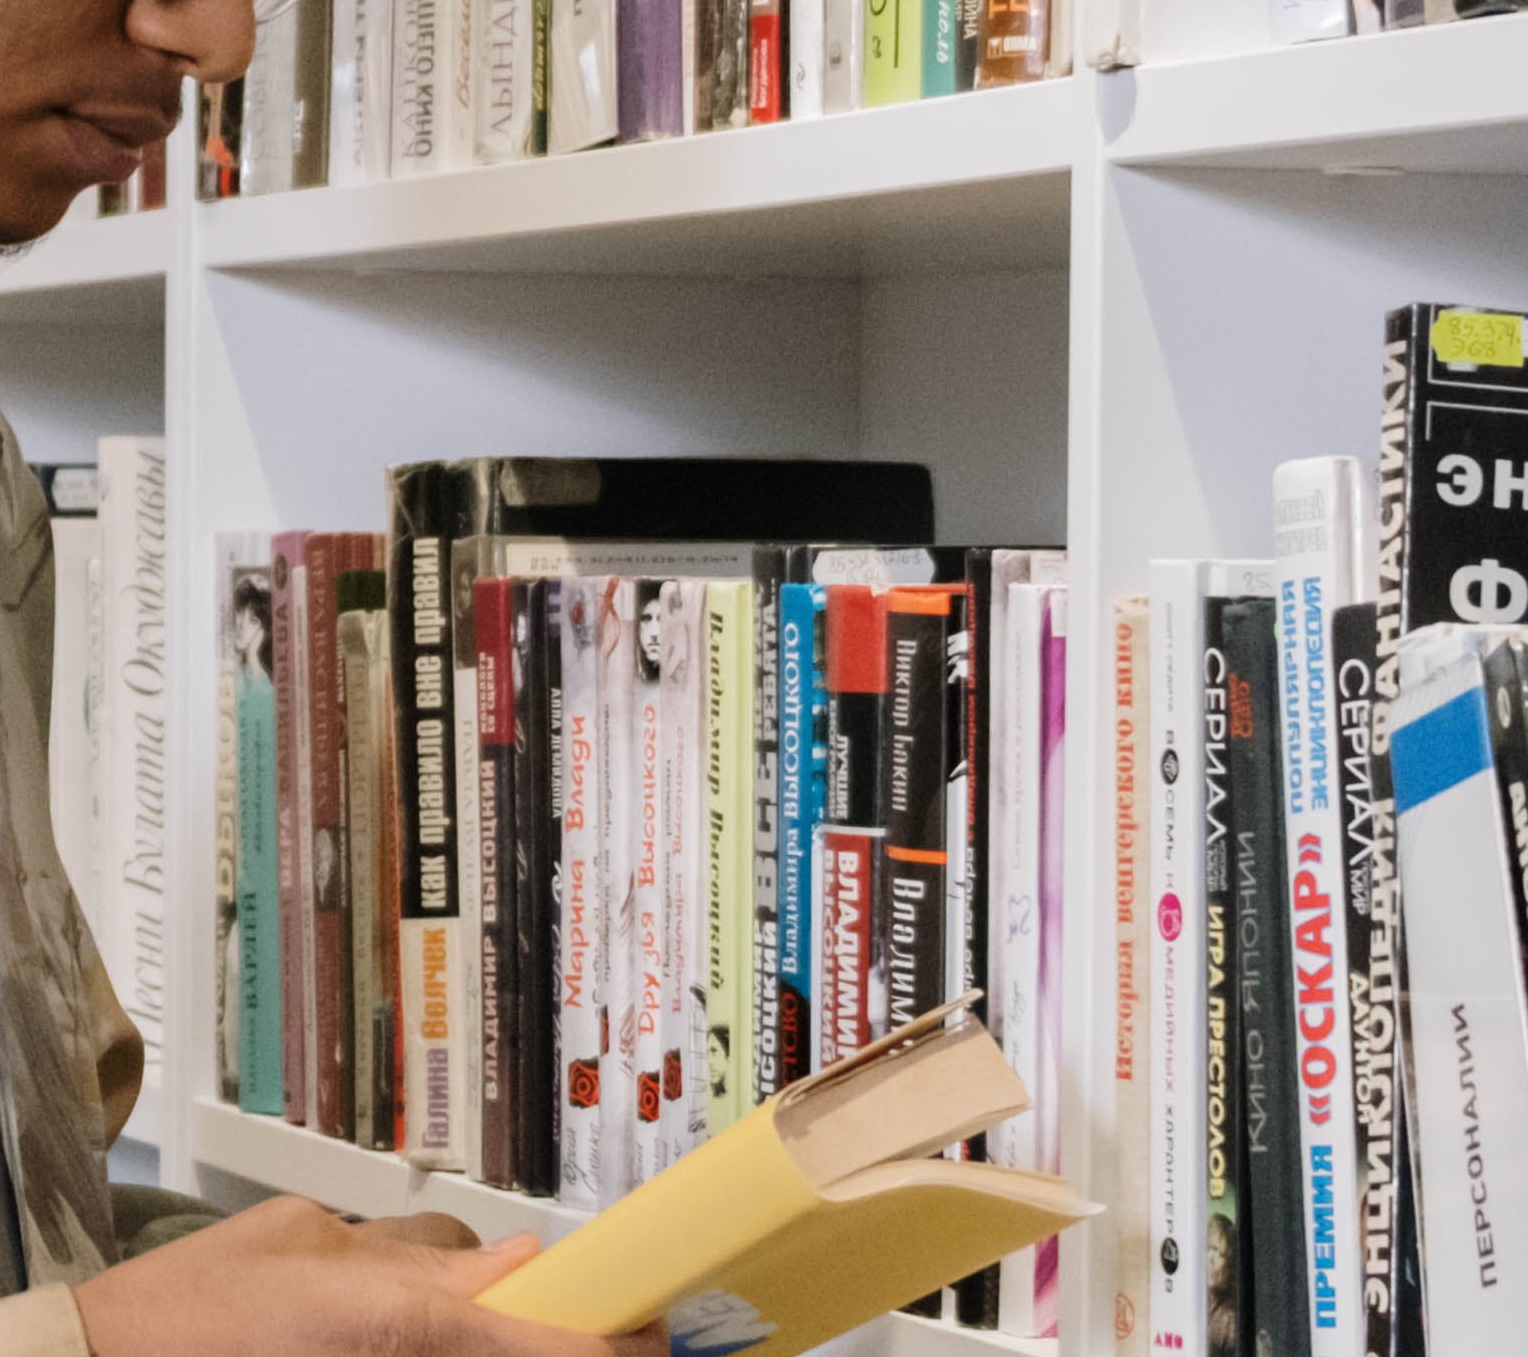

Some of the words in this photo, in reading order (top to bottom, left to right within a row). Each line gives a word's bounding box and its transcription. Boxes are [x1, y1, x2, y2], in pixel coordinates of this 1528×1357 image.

[411, 538, 440, 645] правил
[1113, 622, 1135, 709] кино
[416, 656, 441, 708] вне
[782, 623, 800, 818] ВЫСОЦКОГО
[894, 640, 917, 726] Виктор
[1202, 646, 1227, 842] СЕРИАЛ
[1284, 580, 1305, 813] ПОПУЛЯРНАЯ
[1301, 576, 1326, 810] ЭНЦИКЛОПЕДИЯ
[418, 719, 448, 843] правило
[479, 760, 497, 923] ВЫСОЦКИЙ
[564, 715, 589, 832] Влади
[636, 706, 658, 887] Высоцкого
[1113, 720, 1139, 925] венгерского
[419, 855, 446, 908] как
[563, 859, 589, 1008] Марина
[782, 830, 801, 974] Владимира
[1210, 906, 1228, 969] ИГРА
[1237, 832, 1262, 1009] ЯПОНИИ
[482, 936, 498, 1099] ВЛАДИМИР
[1113, 941, 1137, 1081] История
[1293, 832, 1337, 1127] «ОСКАР»
[419, 1048, 448, 1149] Галина
[1208, 989, 1228, 1197] ПРЕСТОЛОВ
[1245, 1030, 1269, 1153] КИНО
[1450, 1003, 1498, 1287] ПЕРСОНАЛИИ
[1308, 1145, 1336, 1328] ПРЕМИЯ
